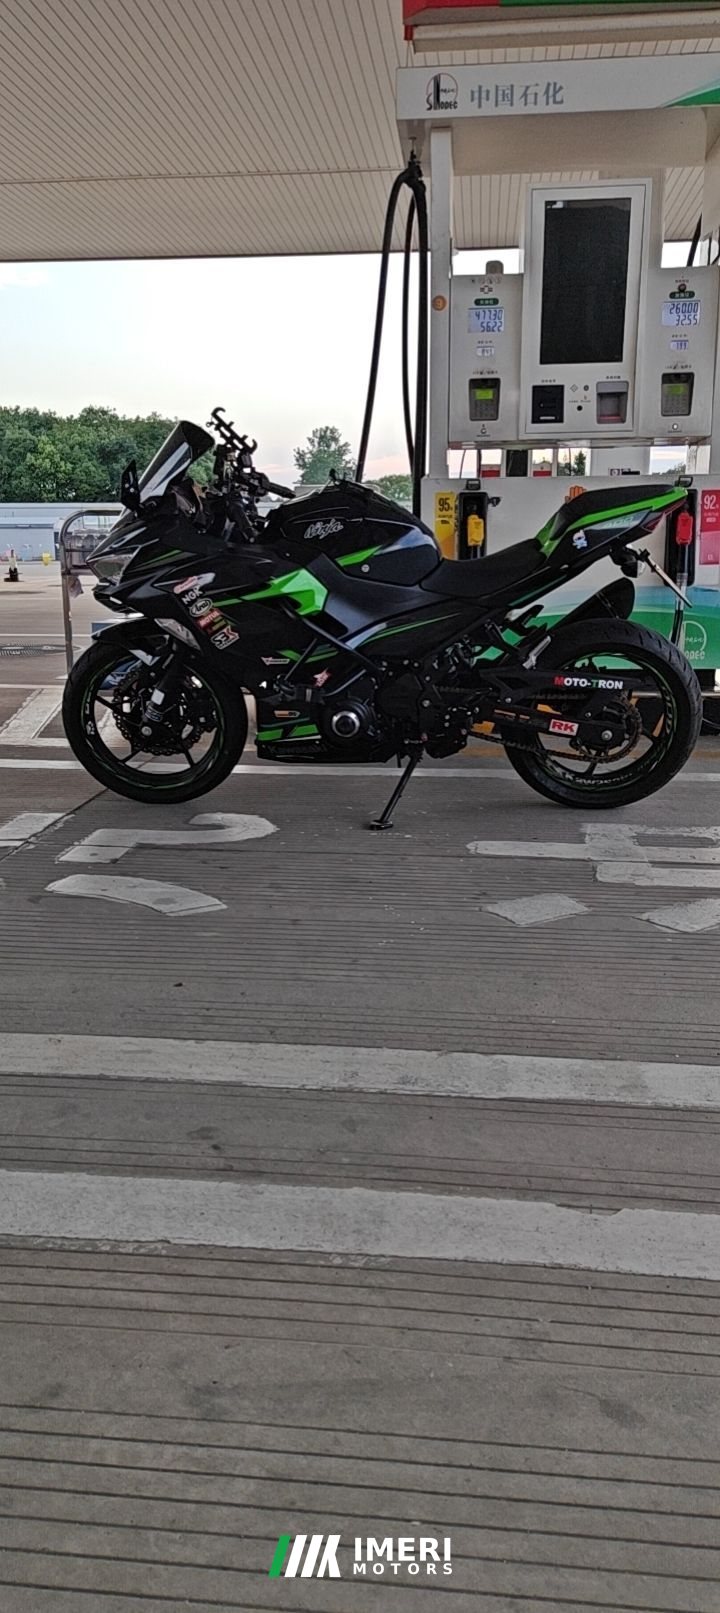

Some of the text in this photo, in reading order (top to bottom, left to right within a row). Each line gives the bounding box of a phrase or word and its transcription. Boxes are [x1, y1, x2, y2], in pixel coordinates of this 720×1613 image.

[470, 82, 564, 109] 中国石化
[304, 518, 344, 539] Ninja
[181, 585, 204, 605] NGK
[554, 676, 624, 690] MOTO-TRON
[551, 721, 575, 733] RK
